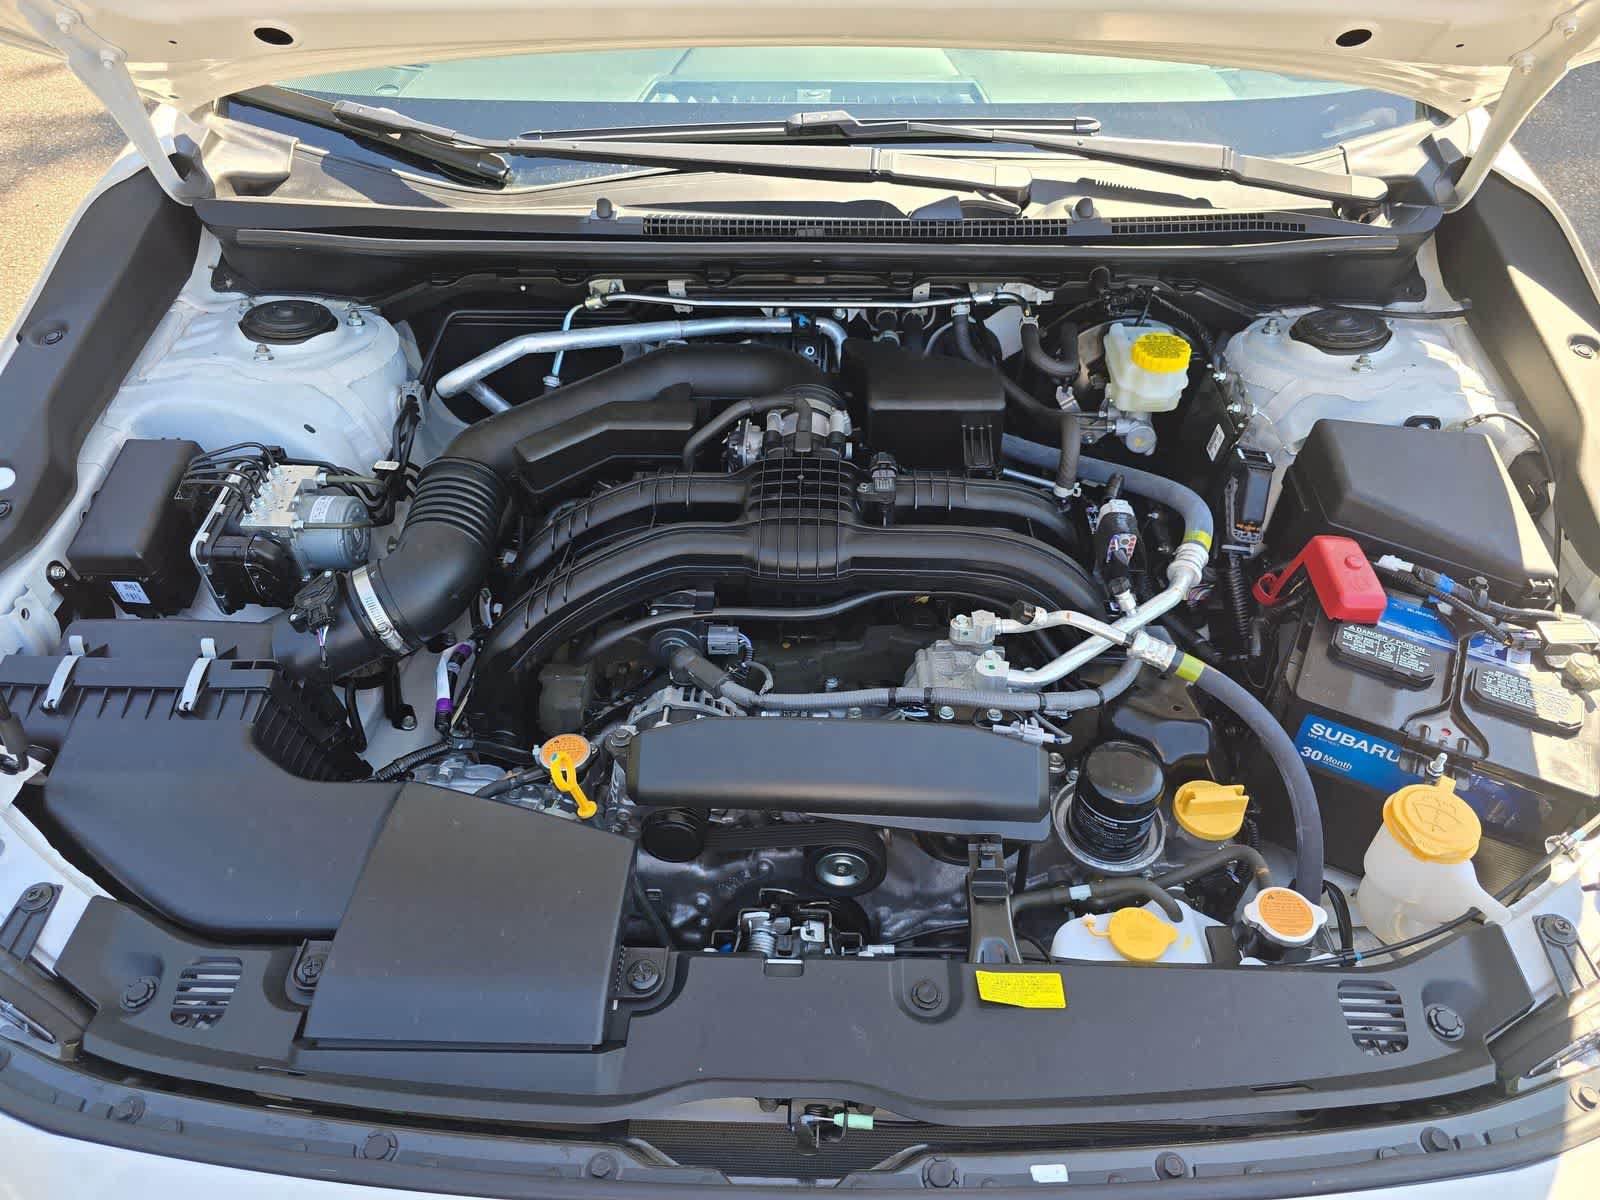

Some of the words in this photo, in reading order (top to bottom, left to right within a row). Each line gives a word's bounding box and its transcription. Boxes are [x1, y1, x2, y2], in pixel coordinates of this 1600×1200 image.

[1300, 746, 1323, 761] 30
[1323, 753, 1353, 770] Month
[1310, 722, 1401, 763] SUBARU
